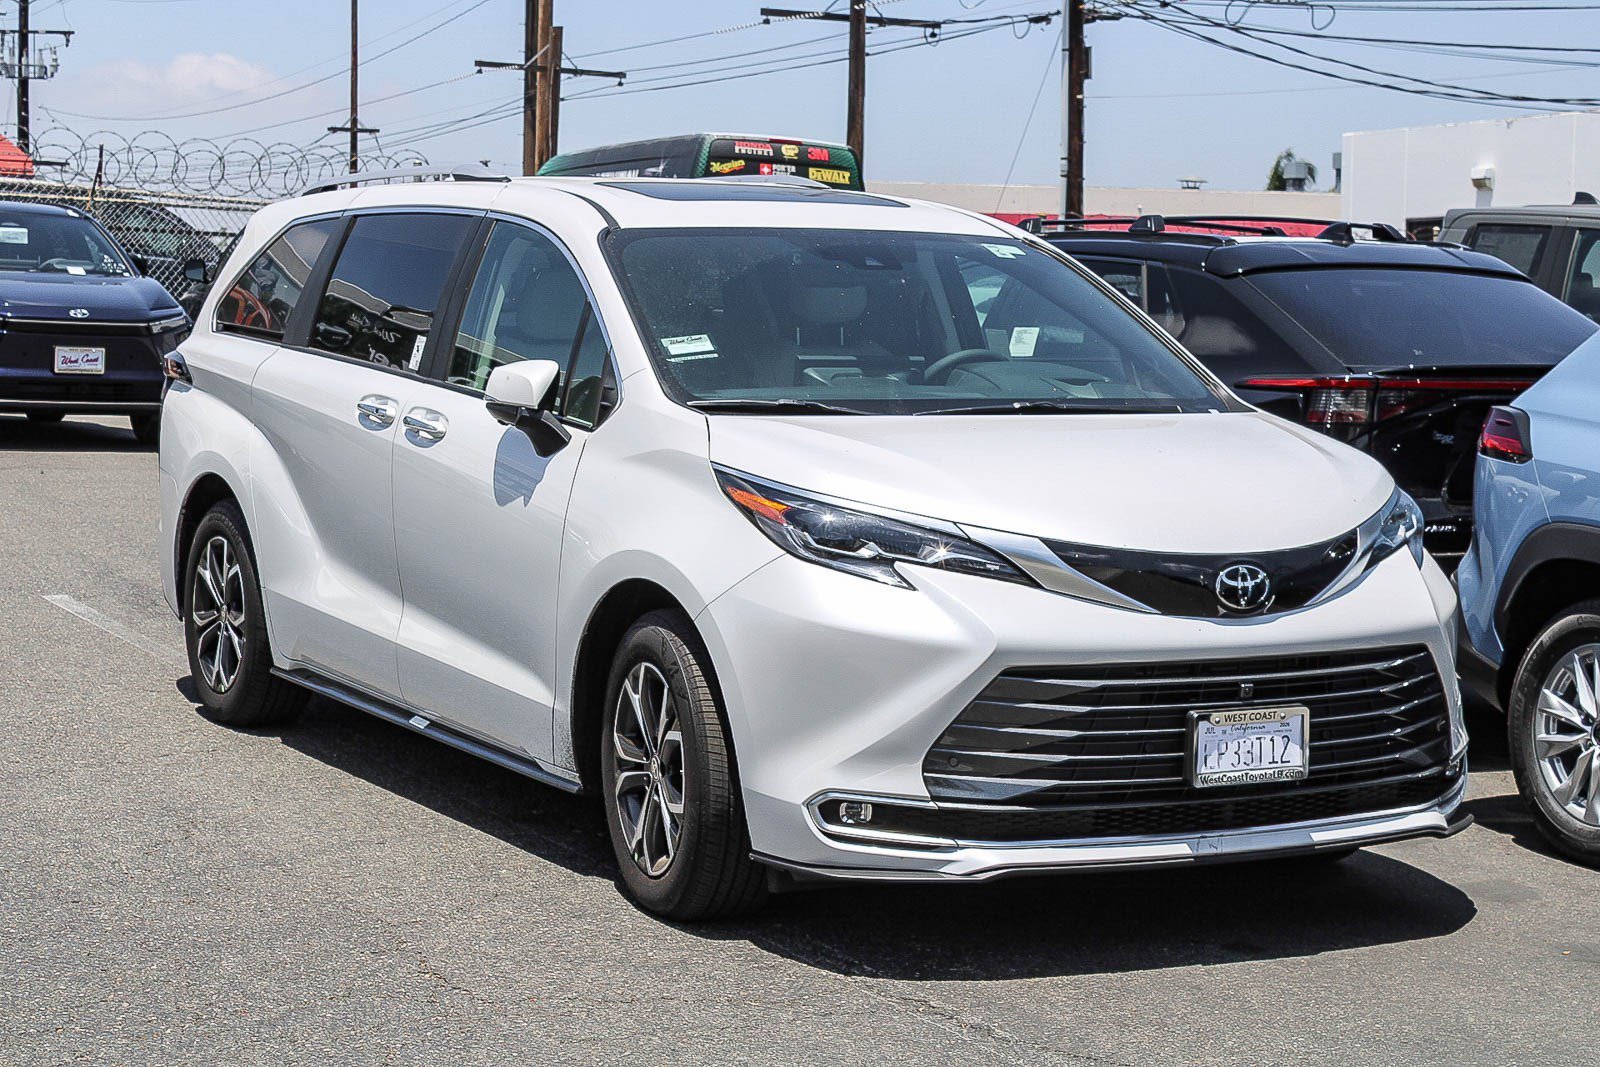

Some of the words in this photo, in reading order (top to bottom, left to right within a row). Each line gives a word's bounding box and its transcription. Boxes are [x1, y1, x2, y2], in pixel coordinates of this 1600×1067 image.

[807, 147, 830, 161] 3M
[1224, 713, 1248, 723] WEST
[1248, 711, 1278, 721] COAST
[1230, 722, 1266, 735] California
